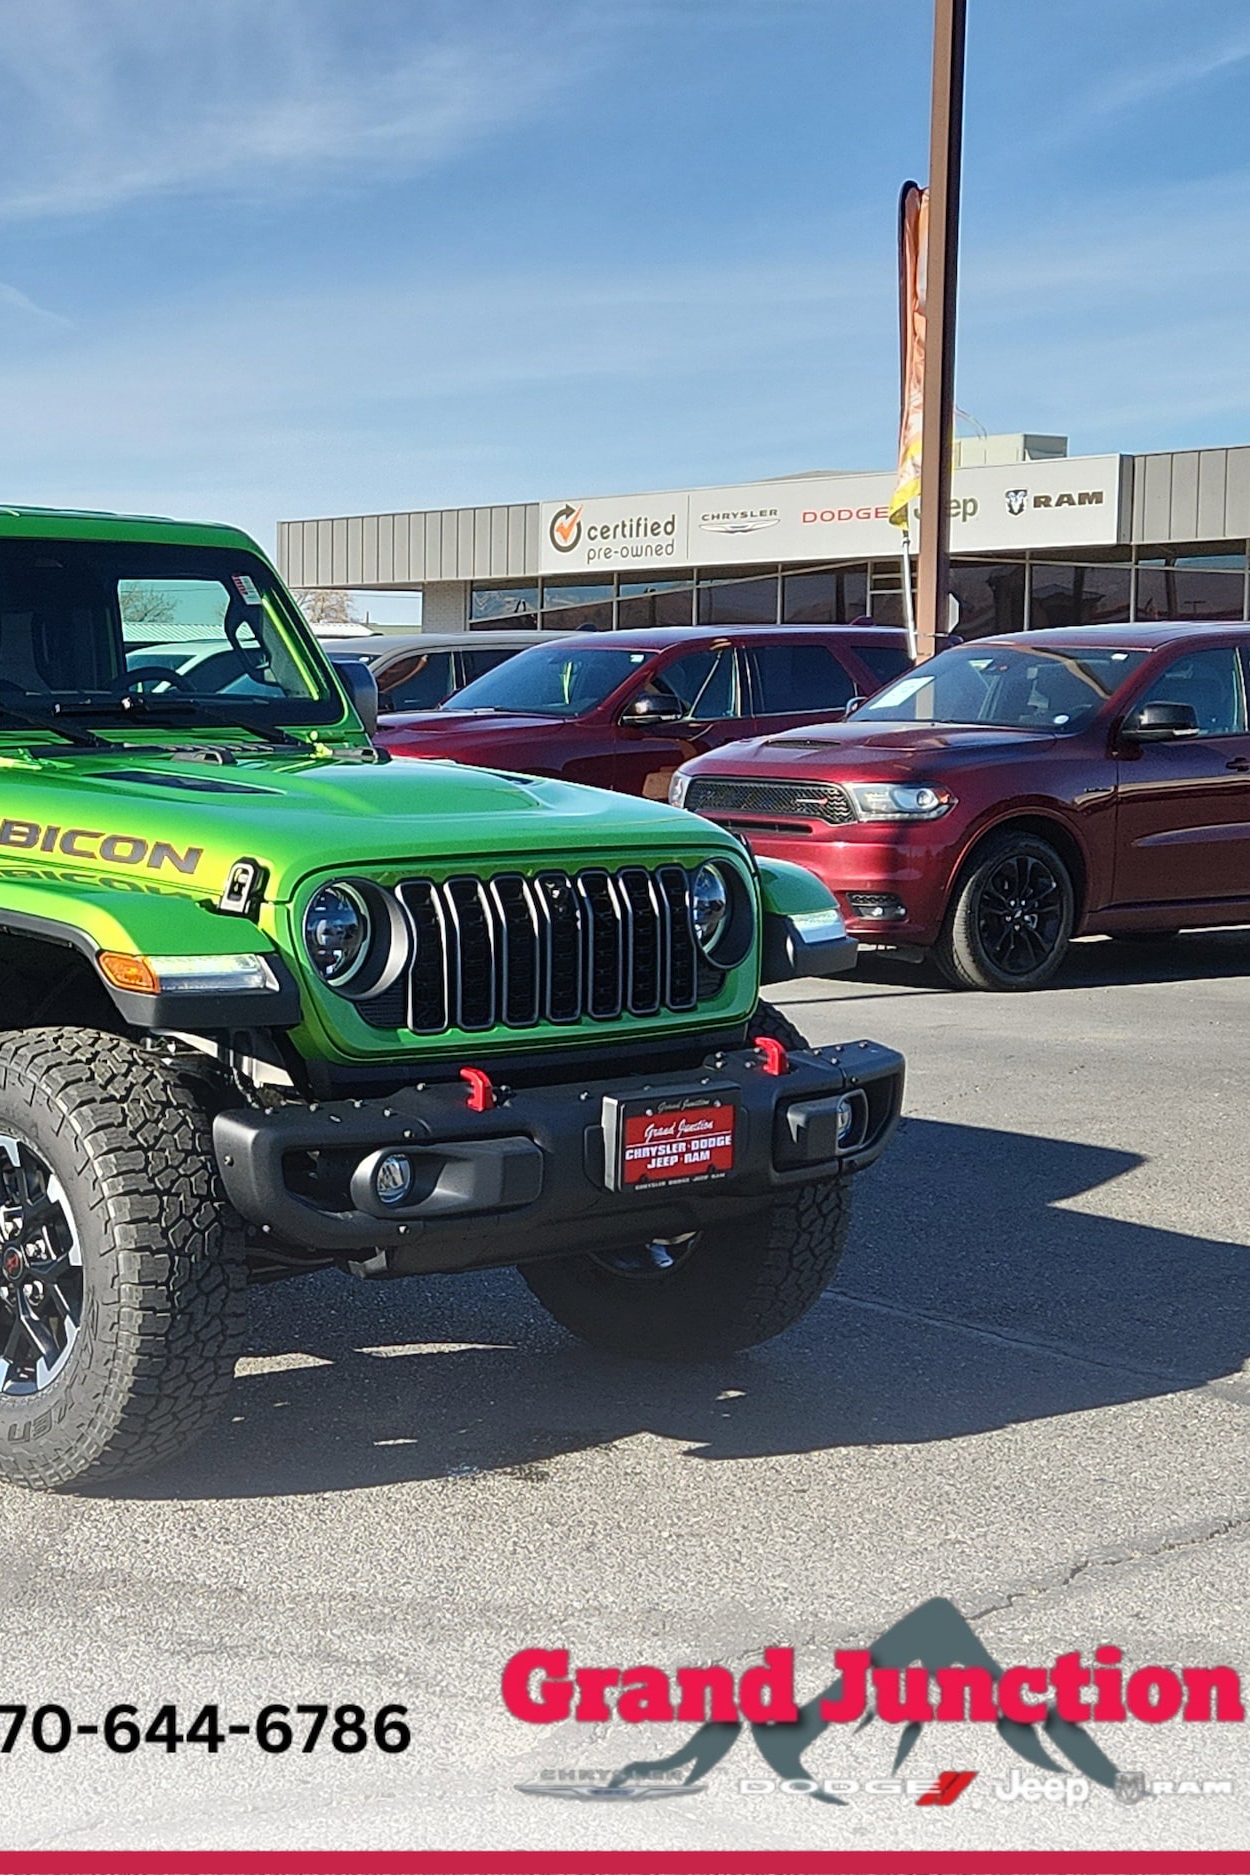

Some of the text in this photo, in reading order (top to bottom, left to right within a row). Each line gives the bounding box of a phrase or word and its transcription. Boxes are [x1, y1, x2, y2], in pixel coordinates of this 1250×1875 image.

[1033, 491, 1104, 508] RAM
[701, 508, 778, 521] CHRYSLER
[802, 506, 889, 524] DODGE
[587, 514, 676, 541] certified
[587, 539, 675, 565] pre-owned
[644, 1118, 714, 1143] Grand Junction
[625, 1135, 732, 1160] CHRYSLER DODGE
[647, 1150, 711, 1169] JEEP RAM
